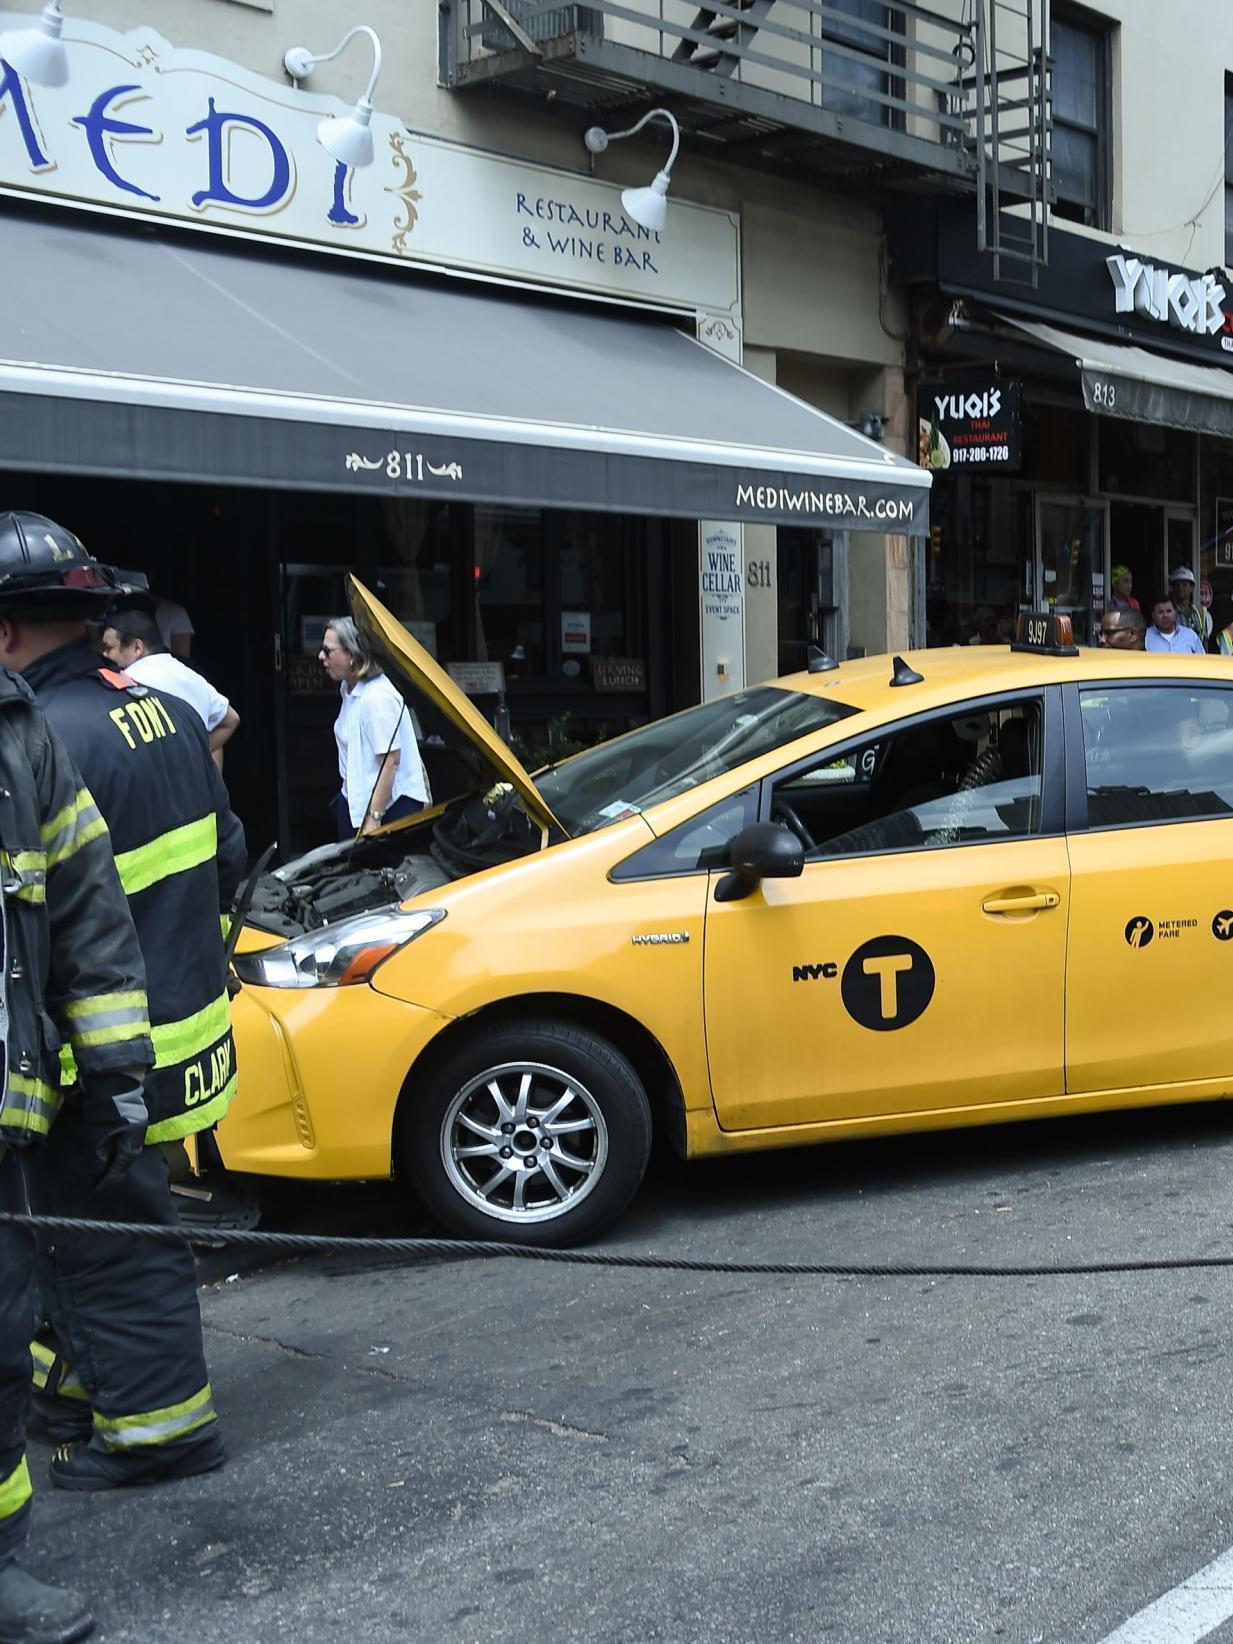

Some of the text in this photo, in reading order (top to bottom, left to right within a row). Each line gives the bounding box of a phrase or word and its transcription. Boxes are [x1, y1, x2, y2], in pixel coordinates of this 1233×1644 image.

[547, 232, 605, 263] WINE
[613, 246, 658, 274] BAR
[1093, 382, 1115, 408] 813
[952, 431, 1009, 445] RESTAURANT
[386, 449, 424, 481] 811
[736, 484, 913, 521] MEDIWINEBAR.COM
[707, 552, 736, 573] WINE
[747, 560, 771, 588] 811
[702, 572, 741, 593] CELLAR
[1028, 619, 1047, 646] 9J97
[109, 697, 177, 750] FDNY
[1158, 918, 1198, 930] METERED
[1158, 929, 1180, 939] FARE
[792, 962, 838, 982] NYC
[862, 953, 913, 1019] T
